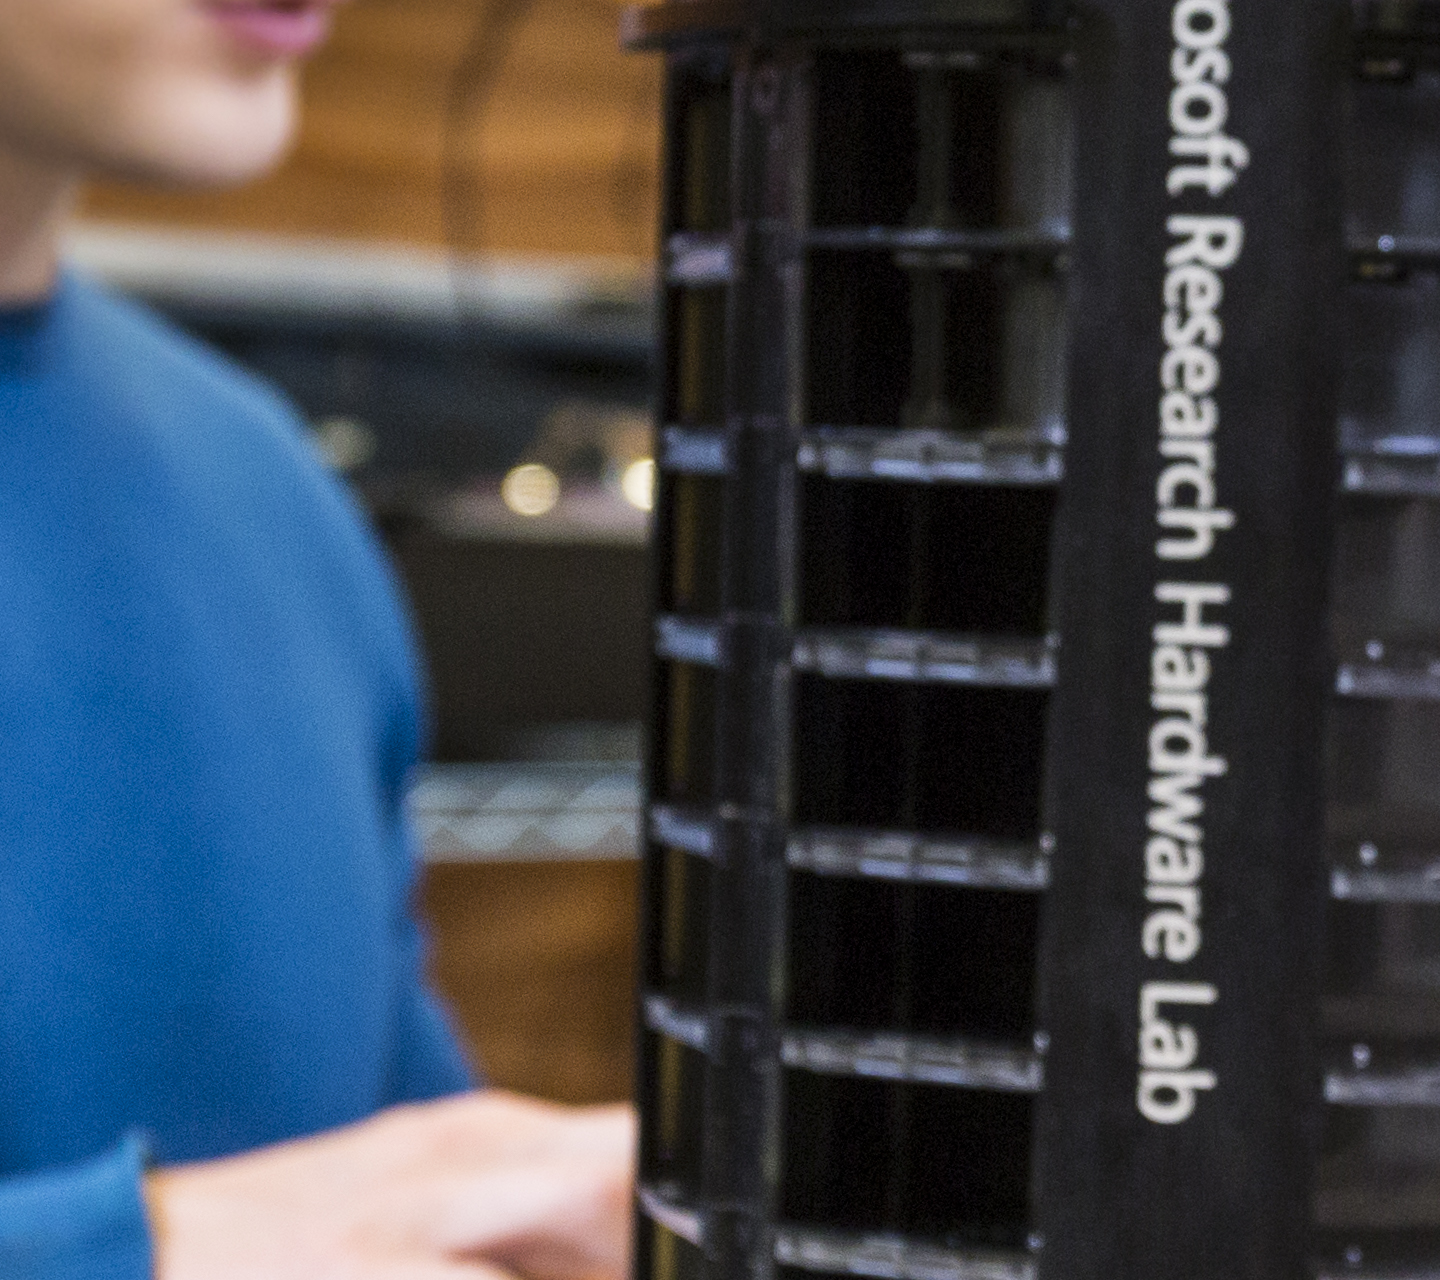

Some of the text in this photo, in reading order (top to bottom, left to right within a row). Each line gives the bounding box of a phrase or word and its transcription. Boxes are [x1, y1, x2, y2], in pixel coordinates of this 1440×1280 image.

[1154, 214, 1244, 561] Research
[1140, 581, 1230, 964] Hardware
[1135, 981, 1218, 1125] Lab
